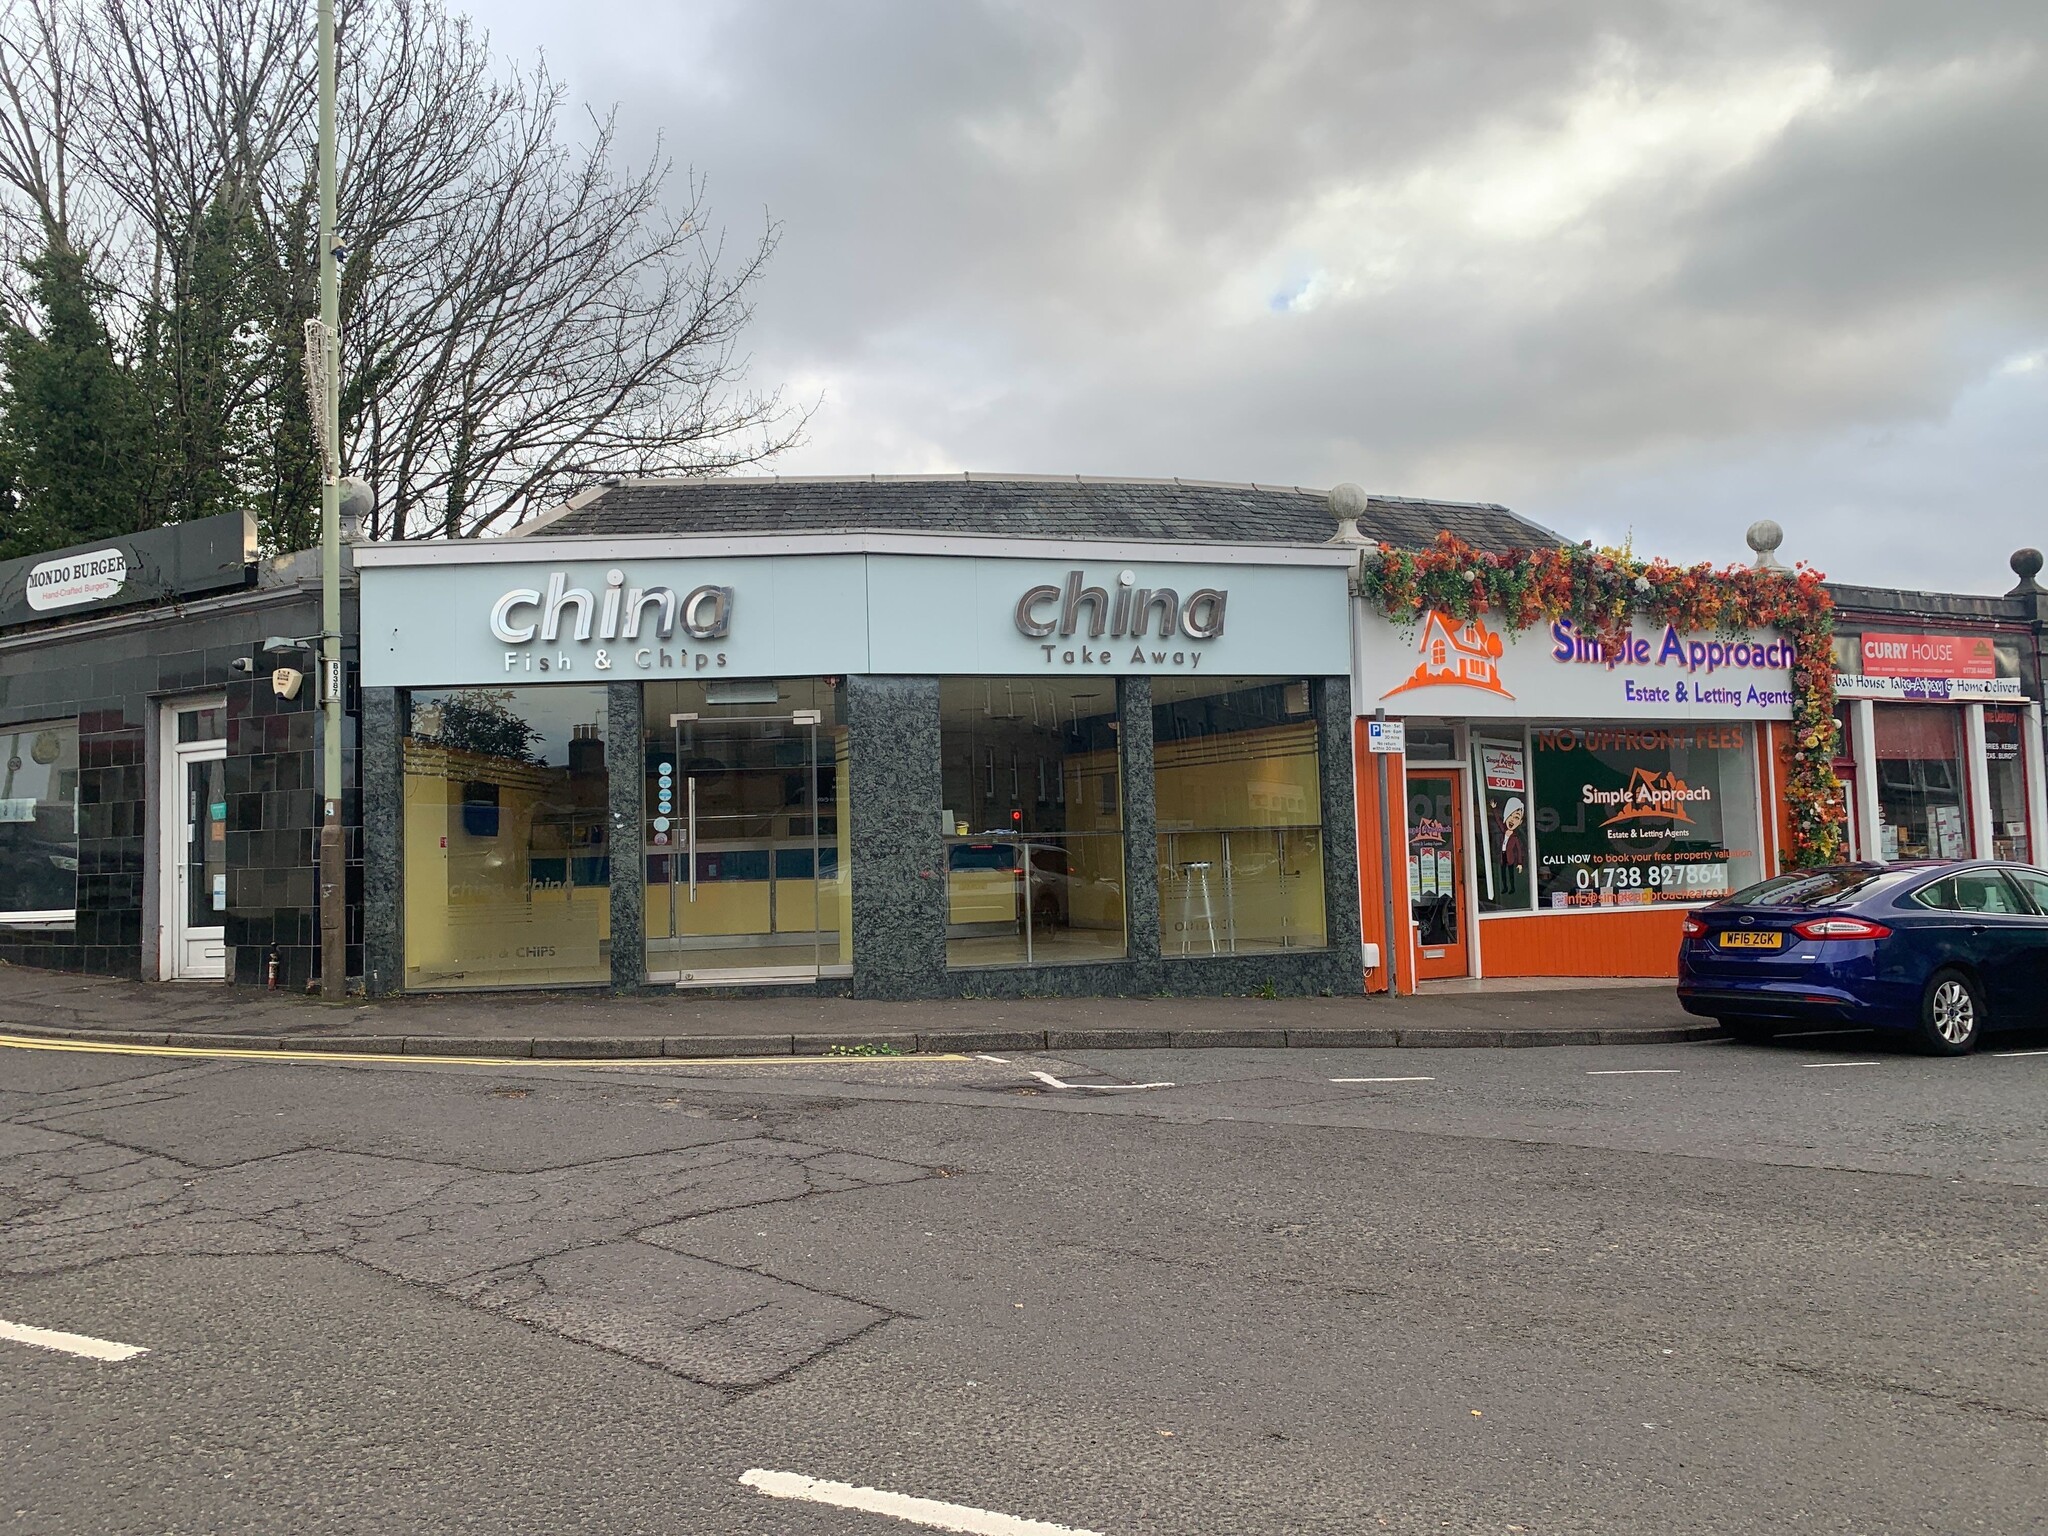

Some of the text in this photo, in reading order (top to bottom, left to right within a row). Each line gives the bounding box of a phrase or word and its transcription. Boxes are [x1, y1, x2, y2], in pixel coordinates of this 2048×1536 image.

[29, 557, 125, 588] MONDO BURGER
[42, 582, 109, 599] Hand-Crafted Burgers
[490, 569, 734, 643] china
[1014, 569, 1228, 638] china
[1041, 645, 1201, 668] Take Away
[1655, 622, 1796, 673] Approach
[1865, 641, 1953, 661] CURRY HOUSE
[504, 649, 727, 672] Fish & Chips
[1625, 680, 1794, 707] Estate & Letting Agents
[1856, 677, 1885, 689] House
[1957, 680, 1983, 691] Home
[1373, 725, 1380, 735] P
[1539, 727, 1744, 751] NO UPFRONT FEES
[1496, 778, 1516, 788] SOLD
[1582, 783, 1711, 806] Simple Approach
[1607, 828, 1689, 839] Estate & Letting Agents
[1543, 848, 1752, 865] CALL NOW to book your free property valuation
[1576, 864, 1723, 889] 01738 827864
[1727, 934, 1774, 945] WF16 ZGK
[516, 946, 556, 958] CHIPS
